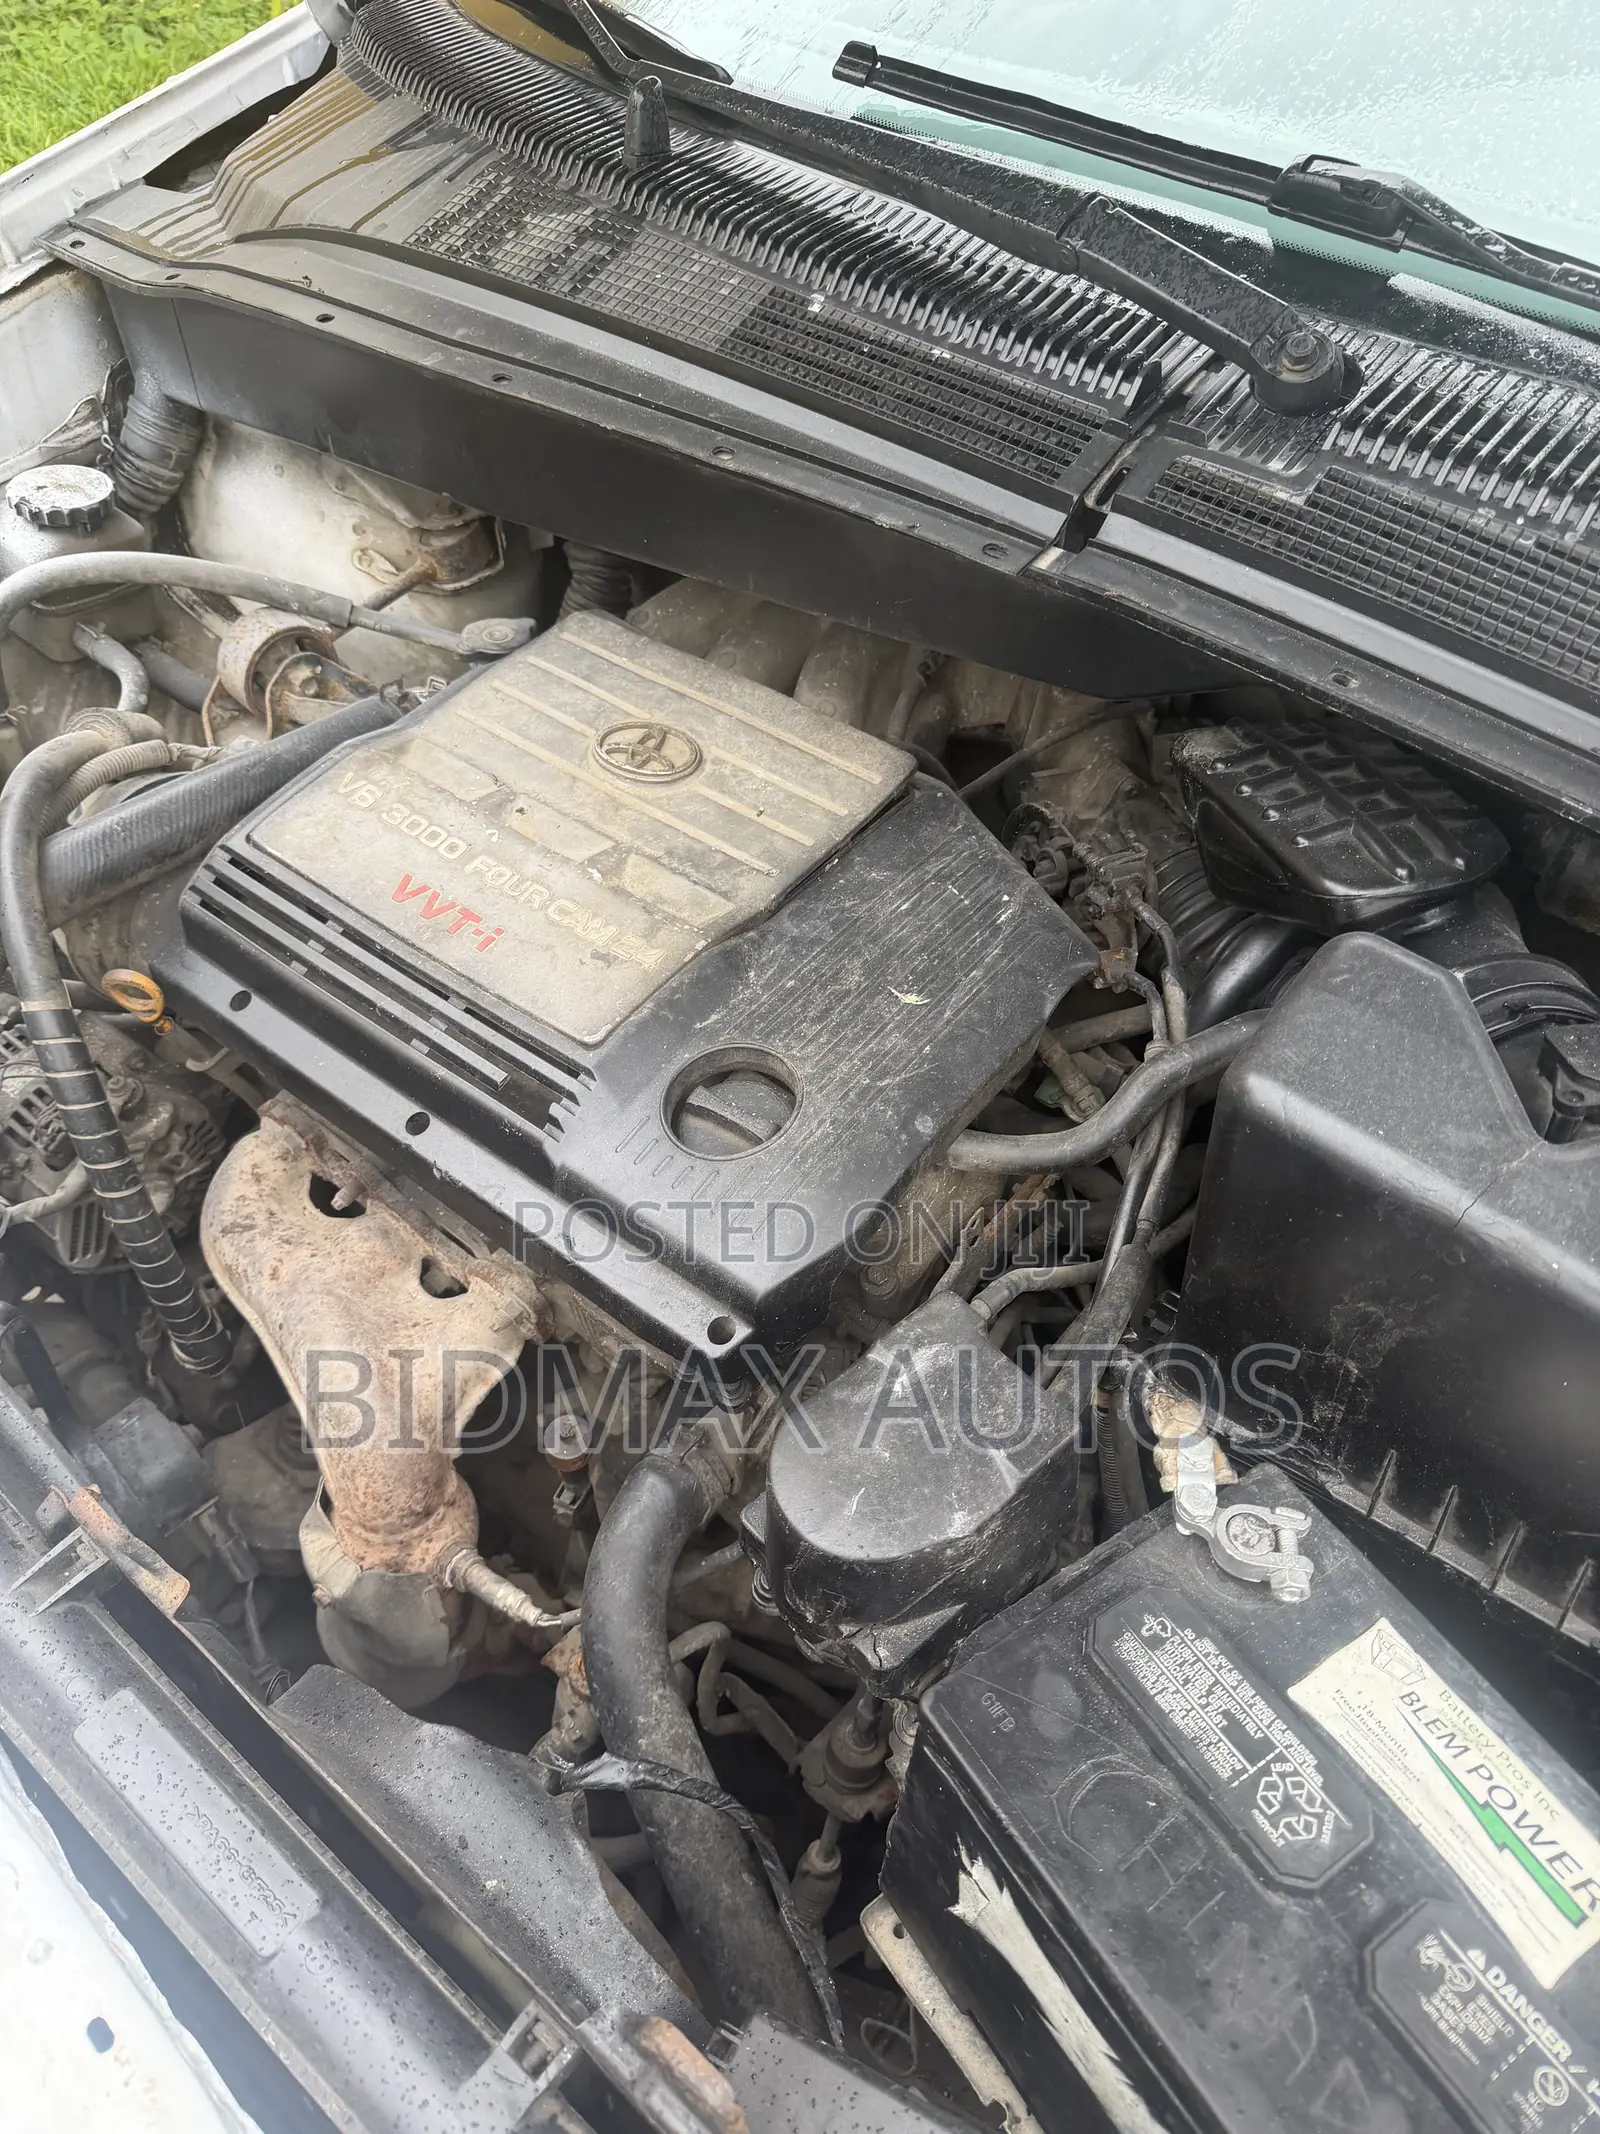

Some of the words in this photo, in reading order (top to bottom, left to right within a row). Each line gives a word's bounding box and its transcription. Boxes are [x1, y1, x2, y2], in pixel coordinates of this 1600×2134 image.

[335, 771, 384, 814] V6
[379, 803, 470, 863] 3000
[465, 852, 554, 913] FOUR
[546, 898, 622, 953] CAM
[606, 934, 667, 972] 24
[390, 871, 505, 953] VVT-i
[1116, 1637, 1157, 1683] INSTRUCTIONS
[1161, 1689, 1186, 1717] VEHICLE
[1146, 1661, 1161, 1676] FOR
[1159, 1675, 1176, 1693] SAFE
[1173, 1693, 1191, 1709] JUMP
[1189, 1710, 1219, 1742] STARTING
[1216, 1742, 1242, 1770] FOLLOW
[1154, 1647, 1186, 1684] MEDICAL
[1184, 1682, 1207, 1704] HELP
[1204, 1705, 1227, 1728] FAST
[1162, 1640, 1184, 1664] WITH
[1208, 1694, 1227, 1712] GET
[1169, 1635, 1196, 1664] FLUSH
[1192, 1662, 1215, 1685] EYES
[1212, 1684, 1263, 1738] IMMEDIATELY
[1184, 1628, 1196, 1639] DO
[1193, 1639, 1209, 1654] NOT
[1219, 1668, 1237, 1686] KEEP
[1235, 1686, 1253, 1705] VENT
[1252, 1705, 1270, 1725] CAPS
[1269, 1723, 1290, 1746] TIGHT
[1287, 1746, 1304, 1763] AND
[1201, 1637, 1218, 1654] KEEP
[1217, 1655, 1233, 1671] OUT
[1230, 1670, 1243, 1682] OF
[1240, 1680, 1256, 1697] THE
[1253, 1695, 1276, 1721] REACH
[1274, 1719, 1287, 1730] OF
[1284, 1730, 1317, 1767] CHILDREN
[1270, 1760, 1294, 1772] LEAD
[1333, 1688, 1358, 1714] Free
[1355, 1713, 1421, 1784] Replacement
[1361, 1703, 1409, 1758] 18-Month
[1438, 1688, 1497, 1752] Battery
[1496, 1750, 1532, 1788] Pros
[1532, 1789, 1561, 1821] Inc
[1399, 1690, 1470, 1760] BLEM
[1466, 1763, 1600, 1912] POWER
[1436, 1985, 1493, 2044] EXPLOSIVE
[1472, 1994, 1514, 2037] SHIELD
[1482, 1966, 1571, 2061] DANGER
[1527, 2091, 1544, 2112] NO
